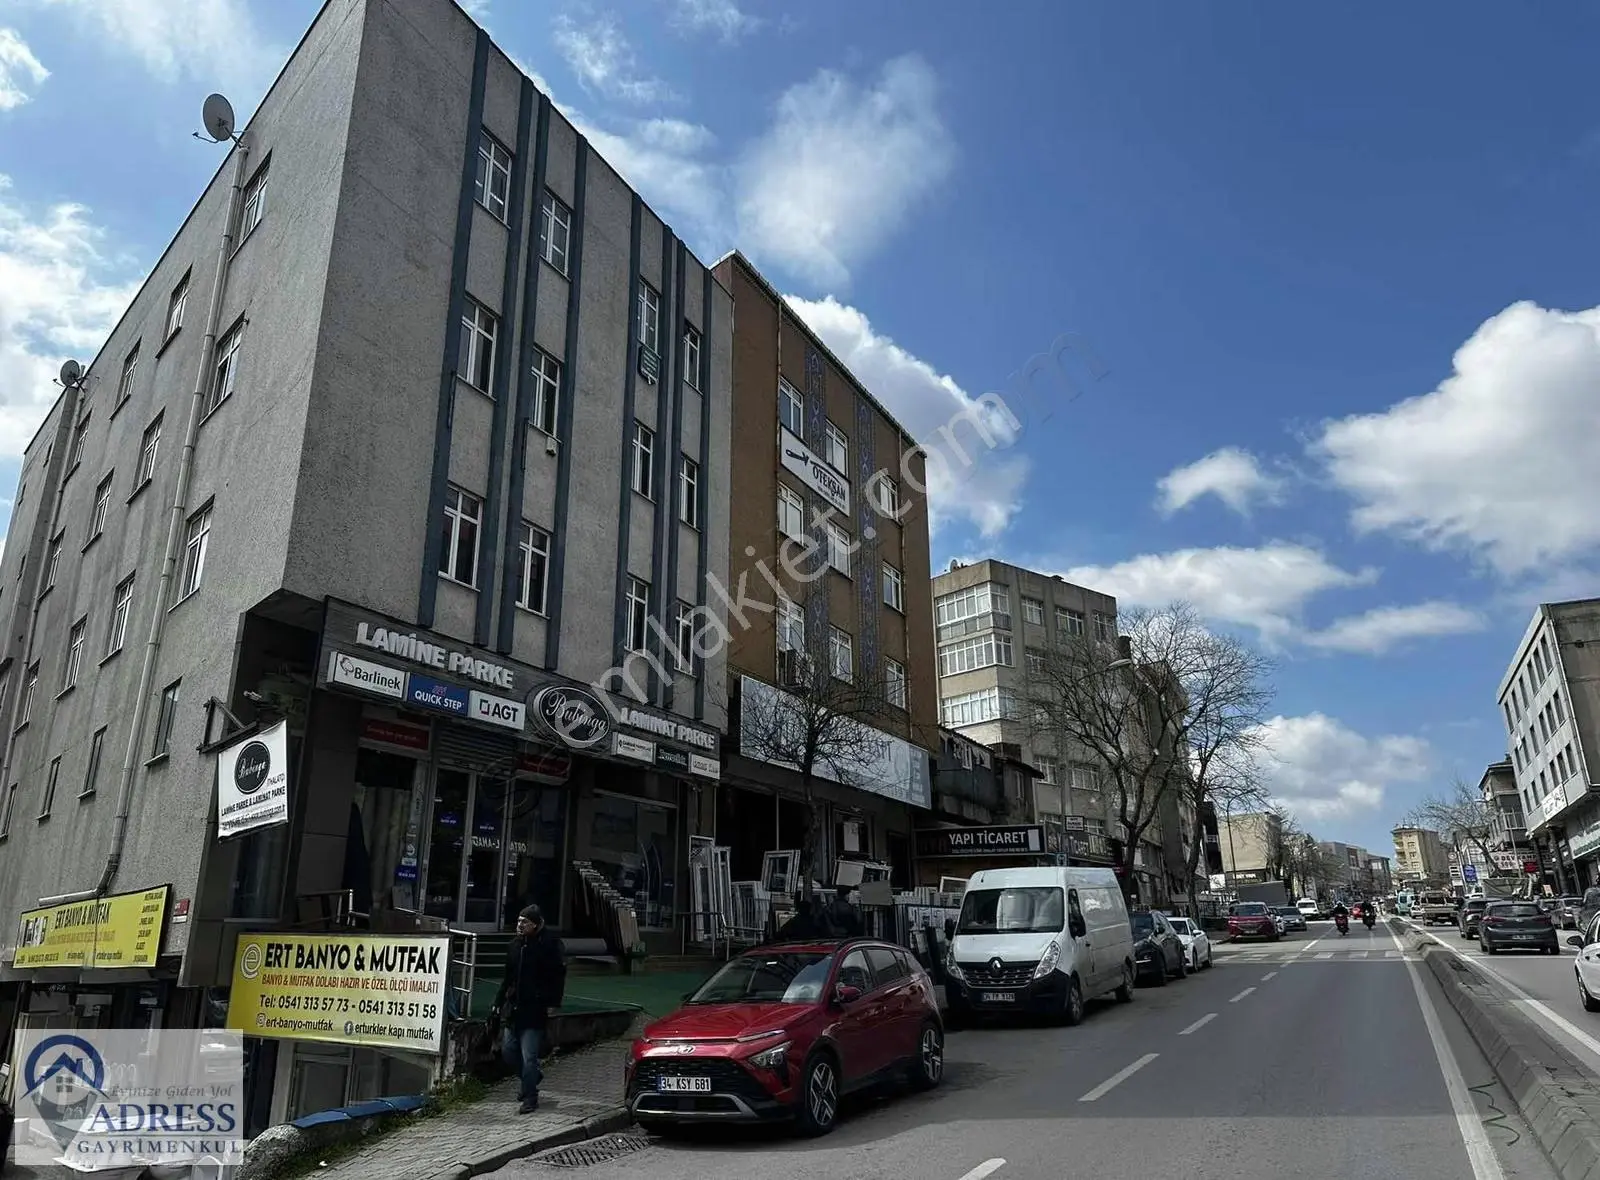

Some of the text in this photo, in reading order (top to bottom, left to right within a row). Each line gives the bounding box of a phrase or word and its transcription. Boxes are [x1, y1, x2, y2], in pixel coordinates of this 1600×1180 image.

[355, 622, 514, 690] LAMİNE PARKE
[354, 666, 401, 691] Barlinek
[414, 690, 442, 706] QUICK
[443, 697, 462, 711] STEP
[491, 704, 519, 722] AGT
[546, 690, 607, 738] Bubinga
[677, 725, 715, 750] PARKE
[949, 830, 1026, 845] YAPI TİCARET
[264, 943, 441, 974] ERT BANYO & MUTFAK
[261, 976, 439, 994] BANYO & MUTFAK DOLABI HAZIR VE ÖZEL ÖLÇÜ İMALATI
[260, 994, 276, 1008] Tel:
[278, 995, 301, 1009] 0541
[303, 997, 319, 1010] 313
[321, 998, 334, 1011] 57
[336, 998, 349, 1012] 73
[358, 1000, 384, 1015] 0541
[386, 1001, 404, 1016] 313
[408, 1003, 419, 1018] 51
[423, 1004, 436, 1019] 58
[265, 1018, 333, 1031] ert-banyo-mutfak
[354, 1023, 434, 1041] erturkler kapı mutfak
[662, 1078, 672, 1089] 34
[695, 1079, 709, 1089] 681
